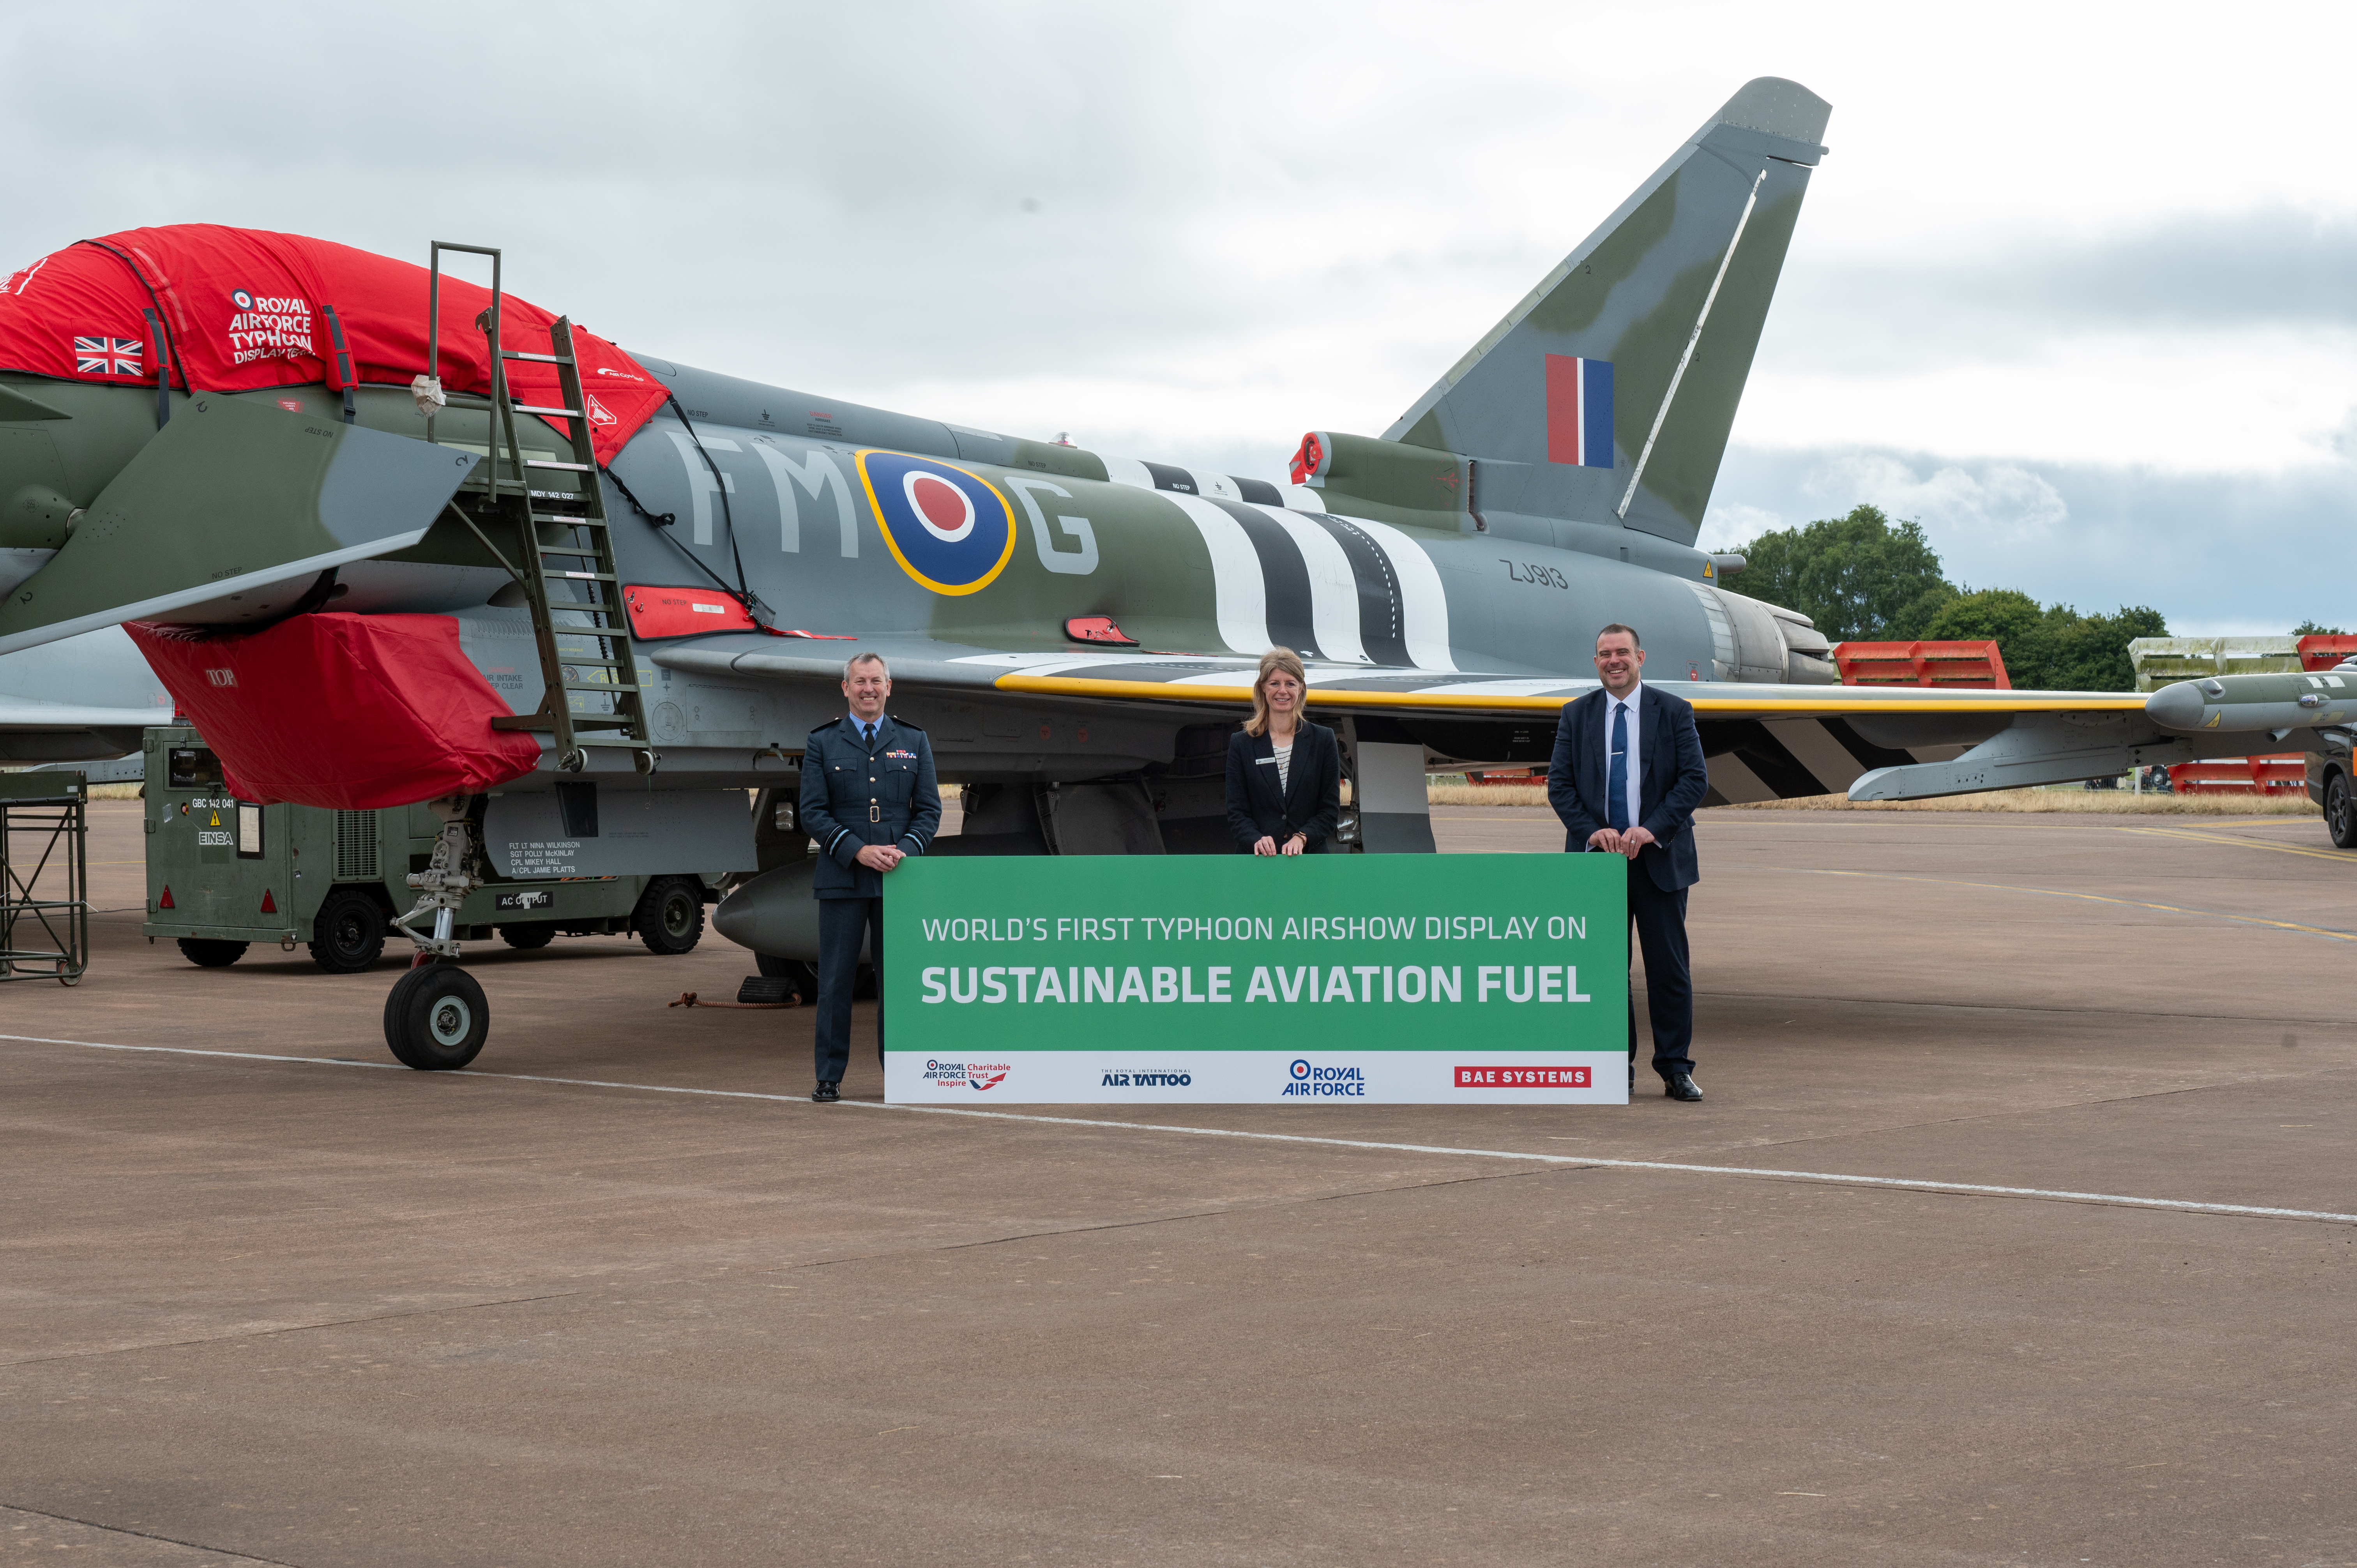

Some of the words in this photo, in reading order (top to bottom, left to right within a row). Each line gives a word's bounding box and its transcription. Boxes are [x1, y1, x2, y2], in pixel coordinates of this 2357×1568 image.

[255, 297, 310, 314] ROYAL
[229, 330, 313, 352] TYPHOON
[234, 348, 285, 364] DISPLAY
[809, 411, 832, 419] DANGER
[305, 427, 322, 435] STEP
[1004, 477, 1099, 575] G
[225, 567, 242, 576] STEP
[1498, 559, 1568, 590] ZJ913
[206, 670, 233, 685] TOP
[193, 798, 207, 808] GBC
[209, 799, 220, 808] 142
[222, 799, 233, 808] 041
[199, 832, 233, 845] EINSA
[922, 918, 1047, 941] WORLD'S
[1058, 918, 1134, 941] FIRST
[1141, 917, 1272, 940] TYPHOON
[1282, 916, 1416, 940] AIRSHOW
[1426, 916, 1539, 939] DISPLAY
[1548, 916, 1586, 939] ON
[922, 966, 1232, 1004] SUSTAINABLE
[1245, 965, 1461, 1003] AVIATION
[1478, 965, 1590, 1003] FUEL
[1102, 1074, 1130, 1086] AIR
[1133, 1074, 1191, 1086] TATTOO
[1313, 1068, 1365, 1081] ROYAL
[1462, 1071, 1495, 1083] BAE
[1502, 1071, 1585, 1083] SYSTEMS
[1281, 1083, 1311, 1096] AIR
[1314, 1083, 1365, 1096] FORCE
